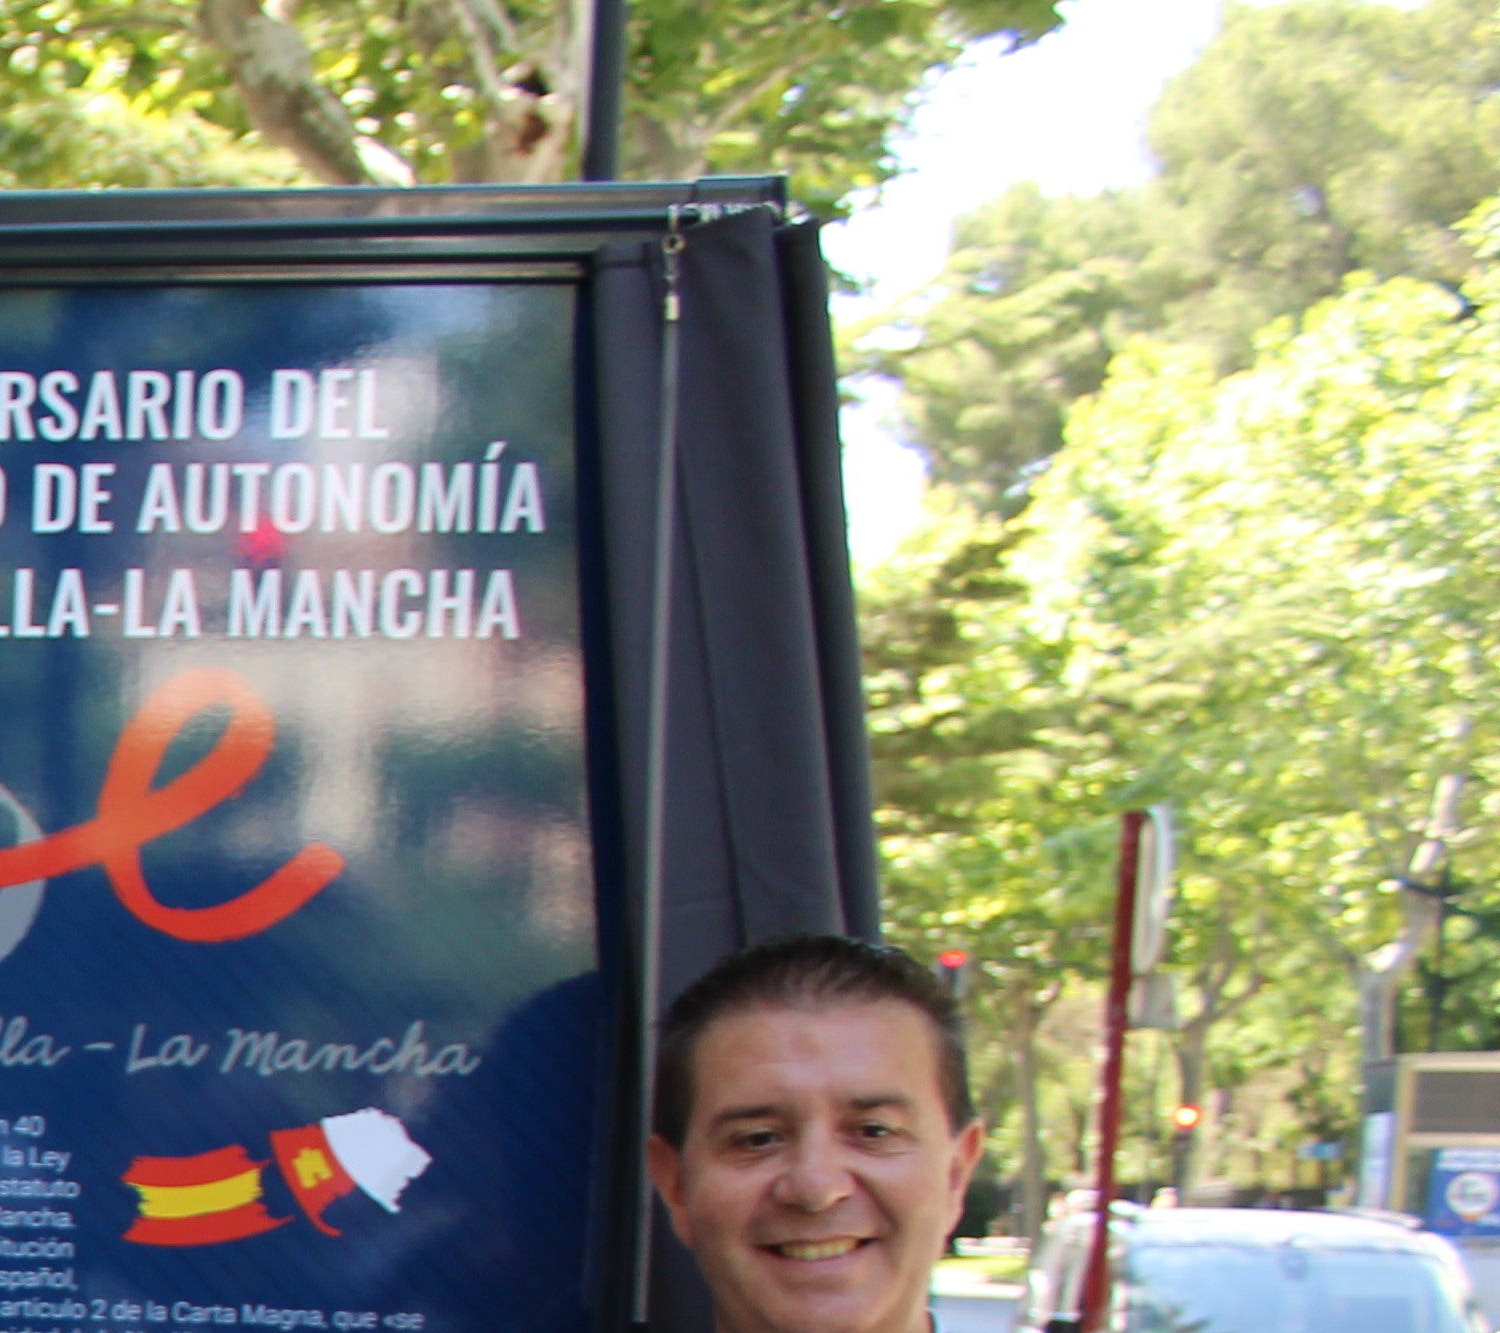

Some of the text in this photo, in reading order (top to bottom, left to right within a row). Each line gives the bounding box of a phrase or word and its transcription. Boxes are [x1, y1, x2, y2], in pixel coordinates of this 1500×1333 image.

[271, 369, 388, 439] DEL
[33, 463, 115, 534] DE
[137, 437, 546, 534] AUTONOMÍA
[228, 567, 520, 639] MANCHA
[127, 1024, 208, 1075] La
[220, 1020, 481, 1079] Mancha
[13, 1113, 46, 1136] 40
[1, 1144, 25, 1167] la
[28, 1145, 72, 1172] Ley
